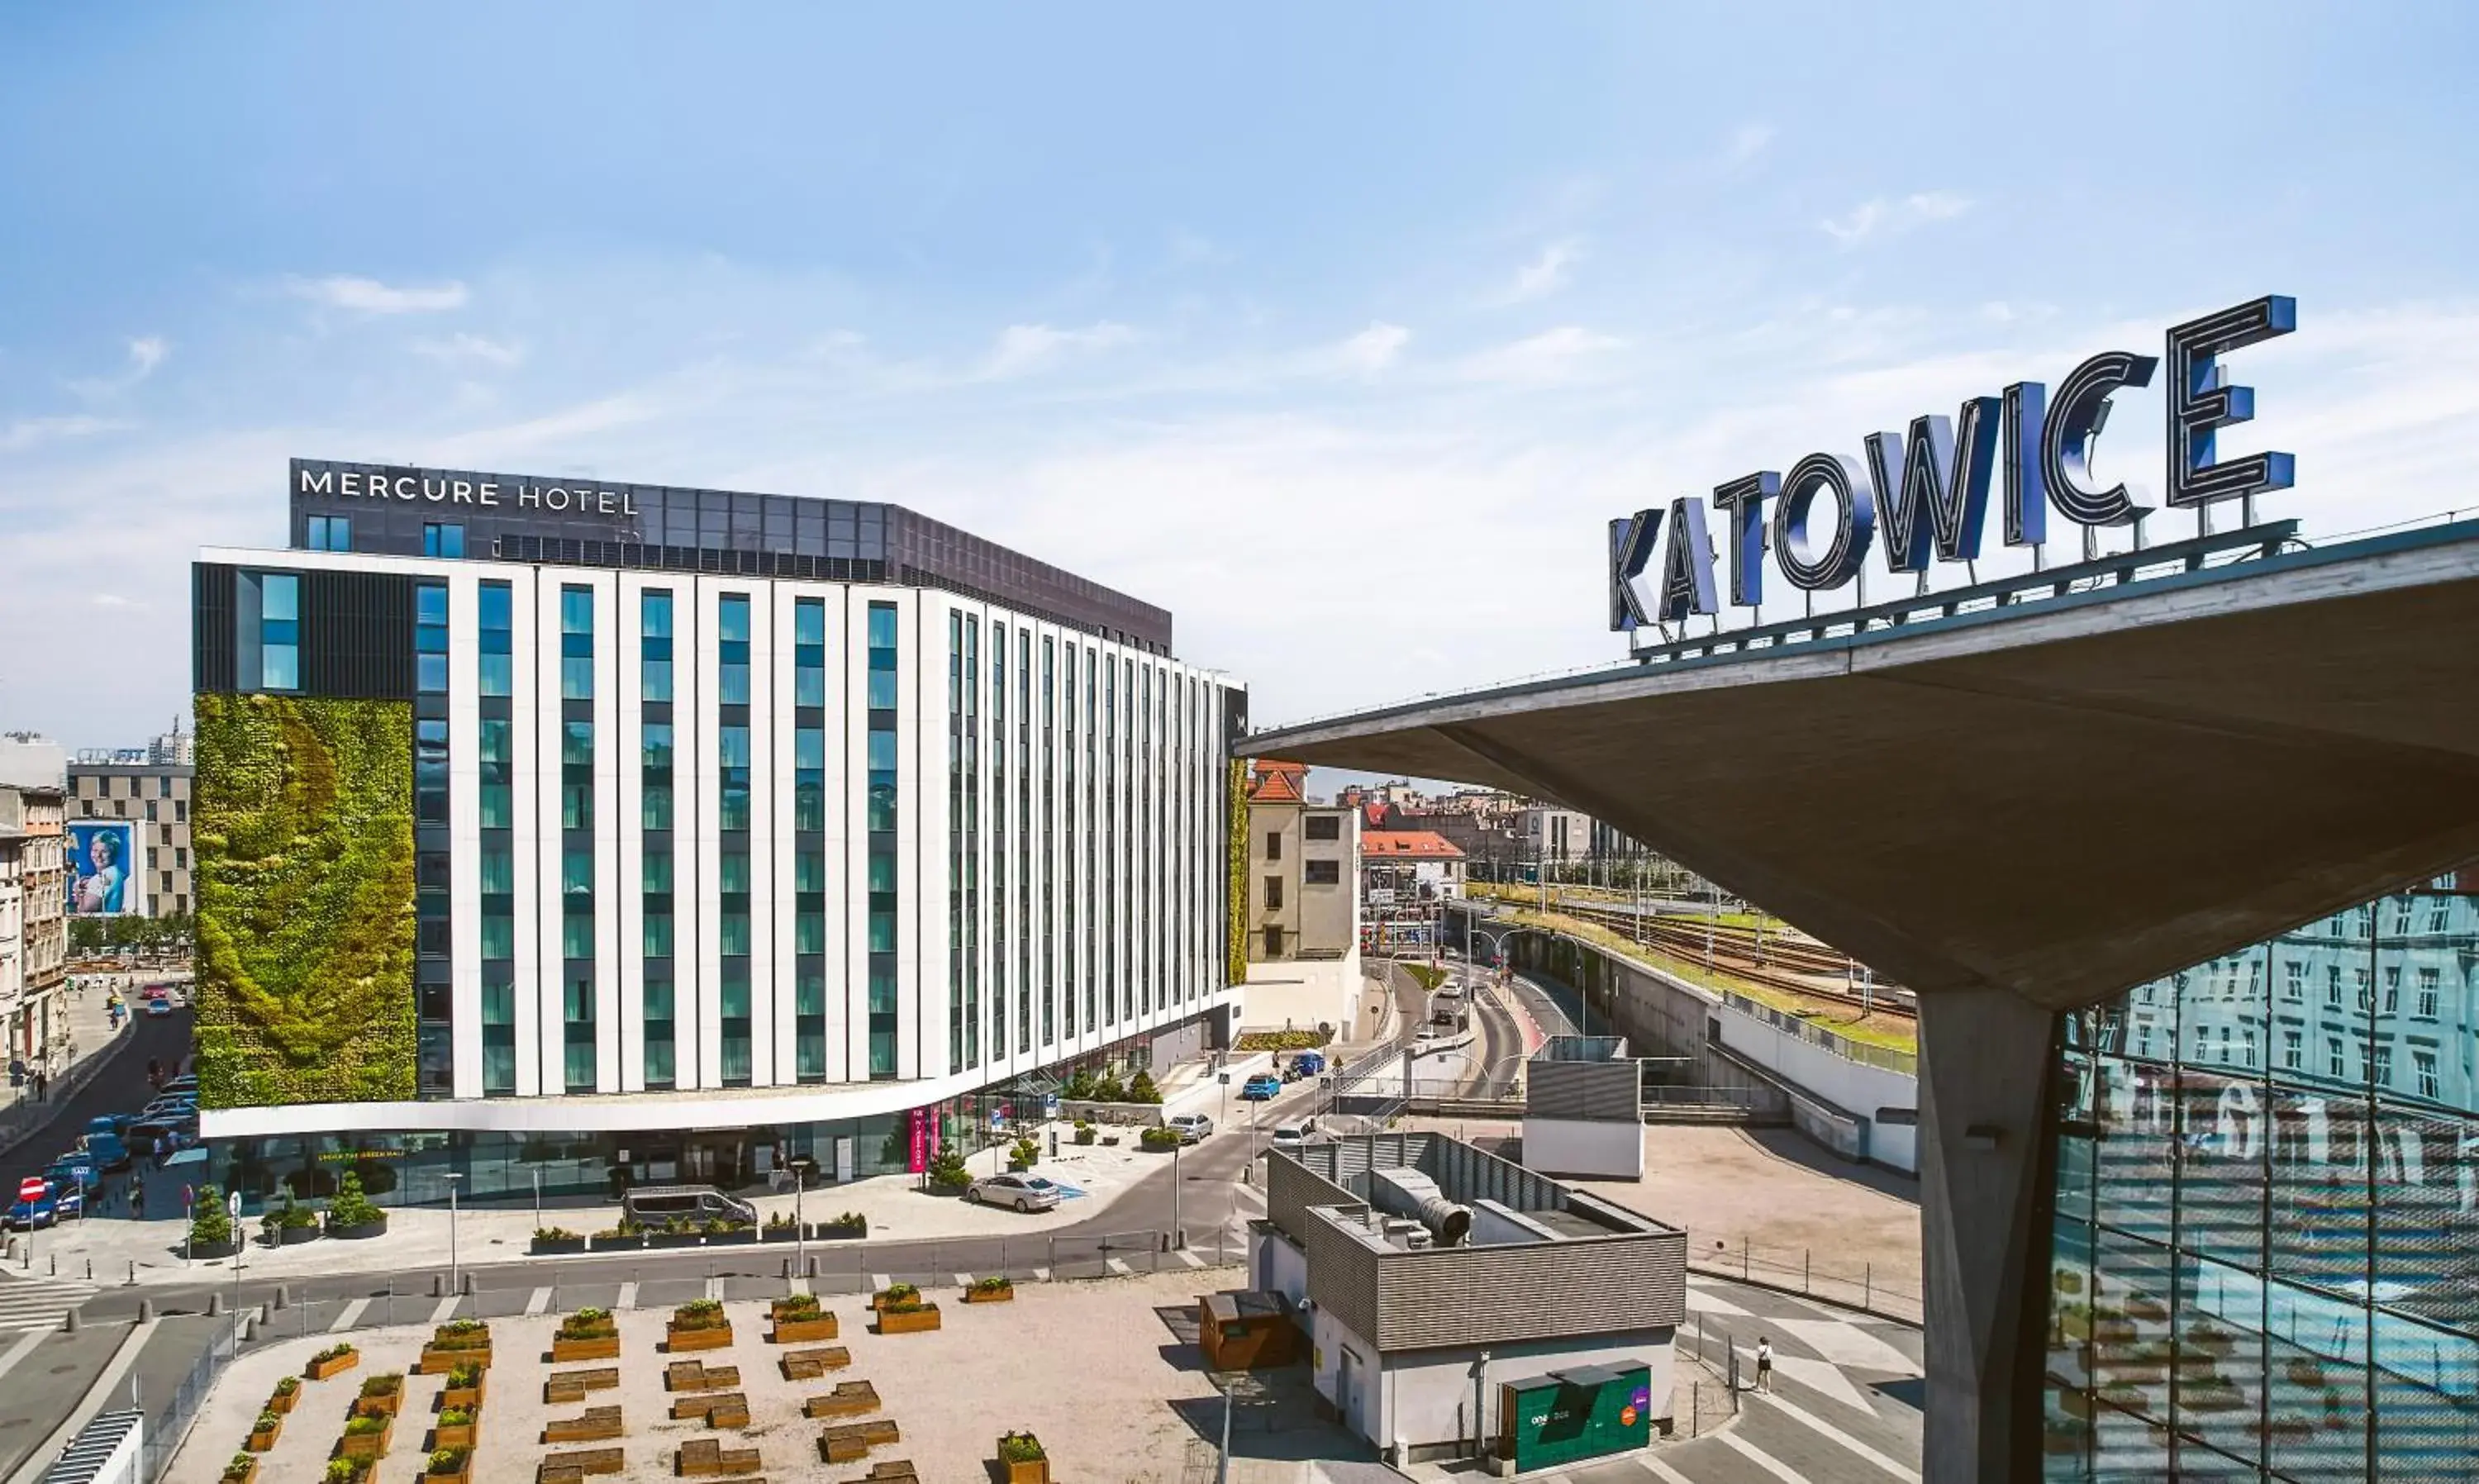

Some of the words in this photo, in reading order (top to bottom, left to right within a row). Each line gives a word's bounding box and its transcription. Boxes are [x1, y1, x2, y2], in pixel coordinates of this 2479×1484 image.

[301, 470, 499, 506] MERCURE
[519, 486, 639, 516] HOTEL
[1609, 295, 2296, 632] KATOWICE
